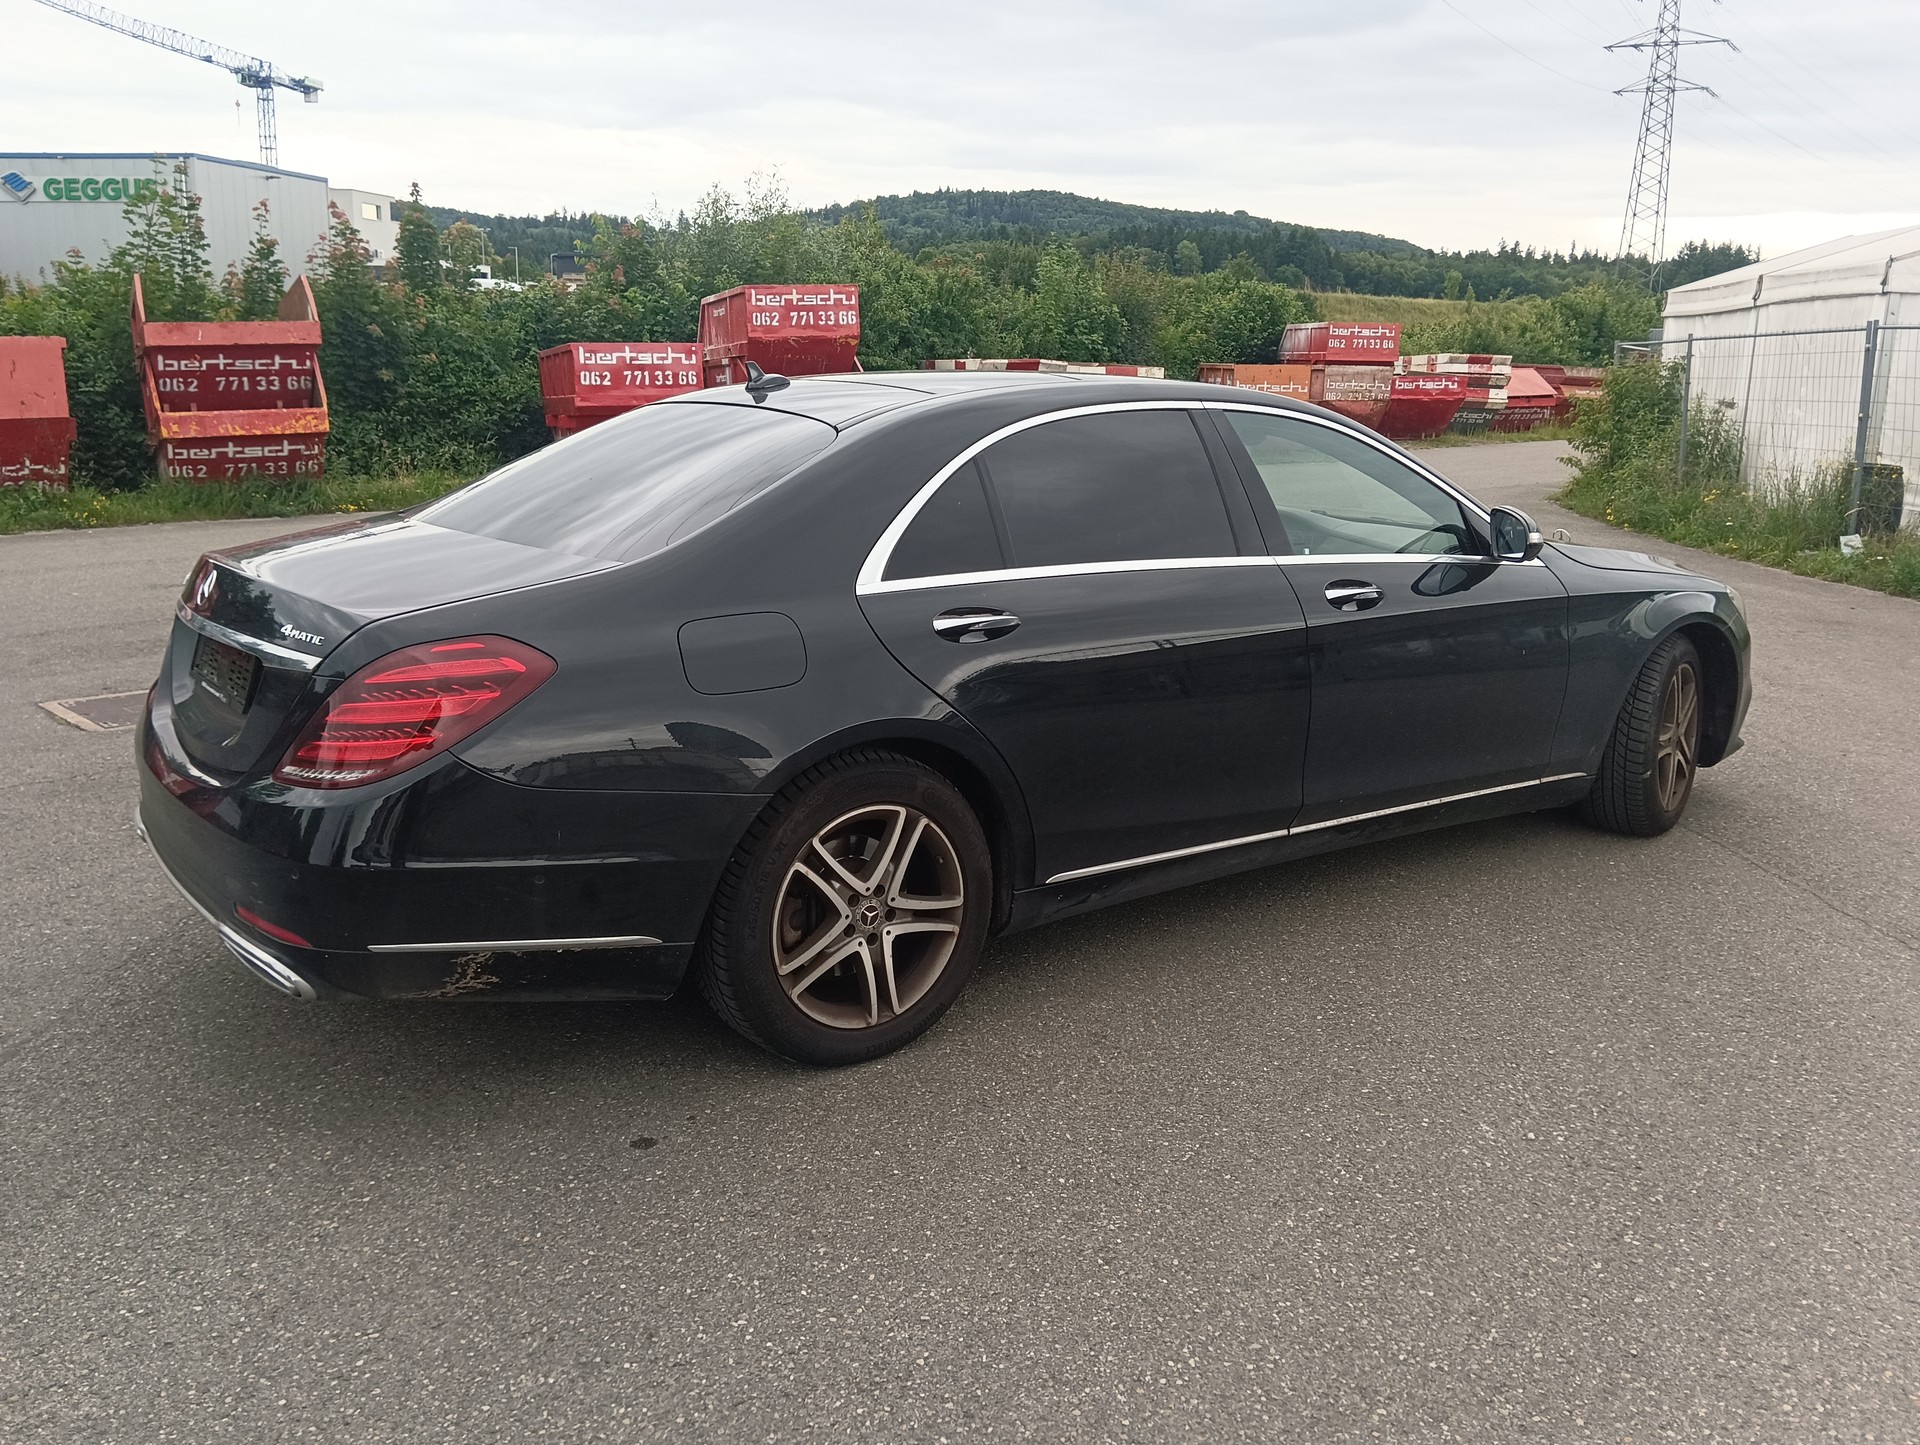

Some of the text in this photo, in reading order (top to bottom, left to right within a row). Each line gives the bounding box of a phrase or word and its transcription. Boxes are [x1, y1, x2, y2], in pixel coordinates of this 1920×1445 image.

[751, 288, 856, 306] bertschi
[752, 311, 857, 326] 062 771 33 66
[1329, 324, 1396, 337] bertschi
[1328, 339, 1394, 349] 062 771 33 66
[157, 351, 311, 371] bertschi
[578, 345, 697, 364] bertschi
[158, 376, 313, 392] 062 771 33 66
[580, 371, 697, 385] 062 771 33 66
[1326, 378, 1392, 391] bertschi
[1395, 376, 1458, 389] bertschi
[167, 438, 319, 459] bertschi
[169, 460, 319, 478] 062 771 33 66
[280, 624, 325, 645] 4MATIC
